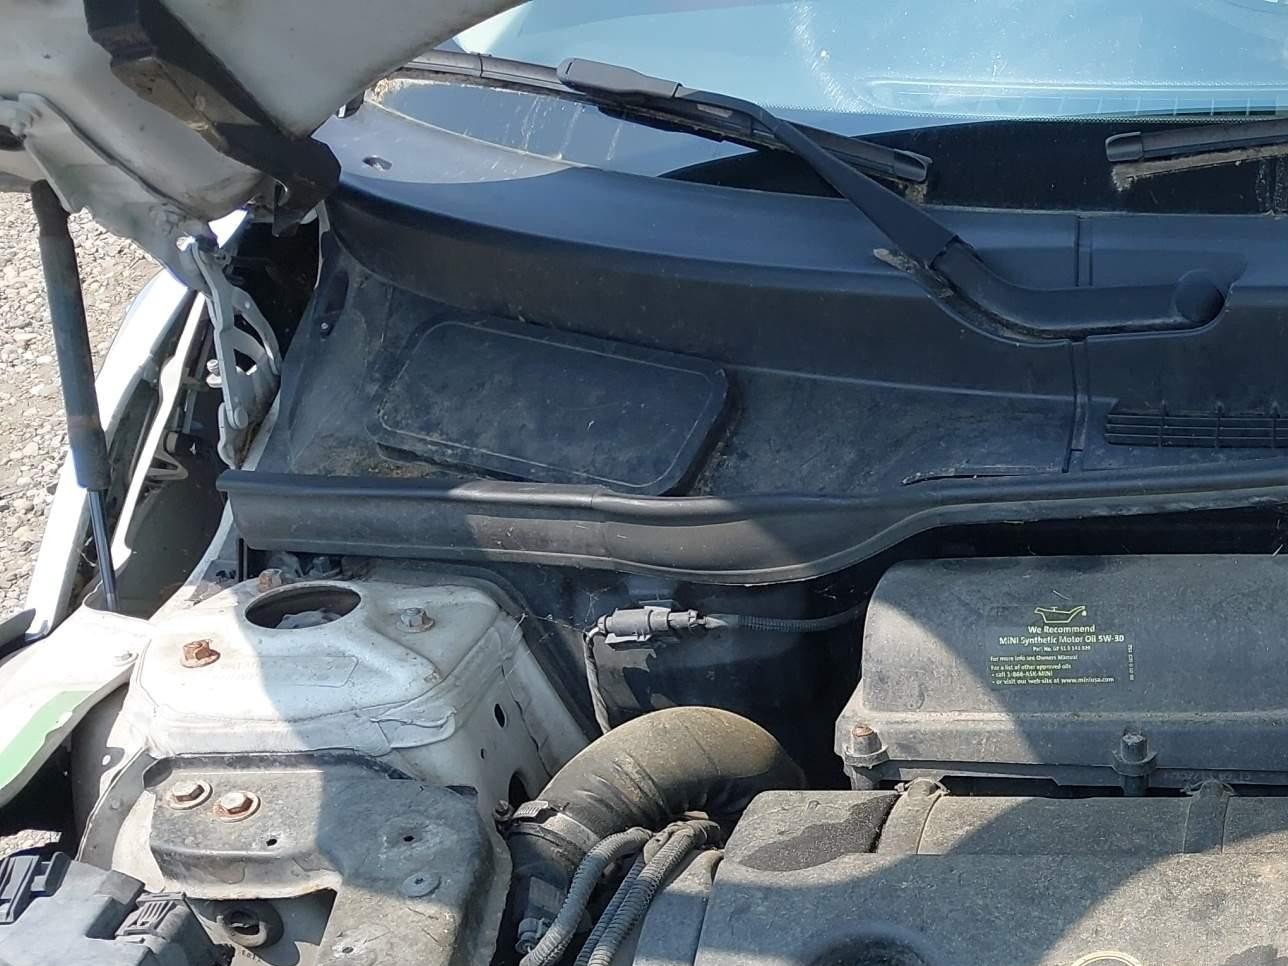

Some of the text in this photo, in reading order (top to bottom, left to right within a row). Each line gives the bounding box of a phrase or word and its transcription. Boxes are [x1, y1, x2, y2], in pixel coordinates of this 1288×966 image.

[1028, 624, 1096, 634] We Recommend
[999, 636, 1019, 645] MINI
[1020, 636, 1058, 646] Synthetic
[1085, 635, 1097, 643] Oil
[1098, 634, 1125, 642] 5W-30
